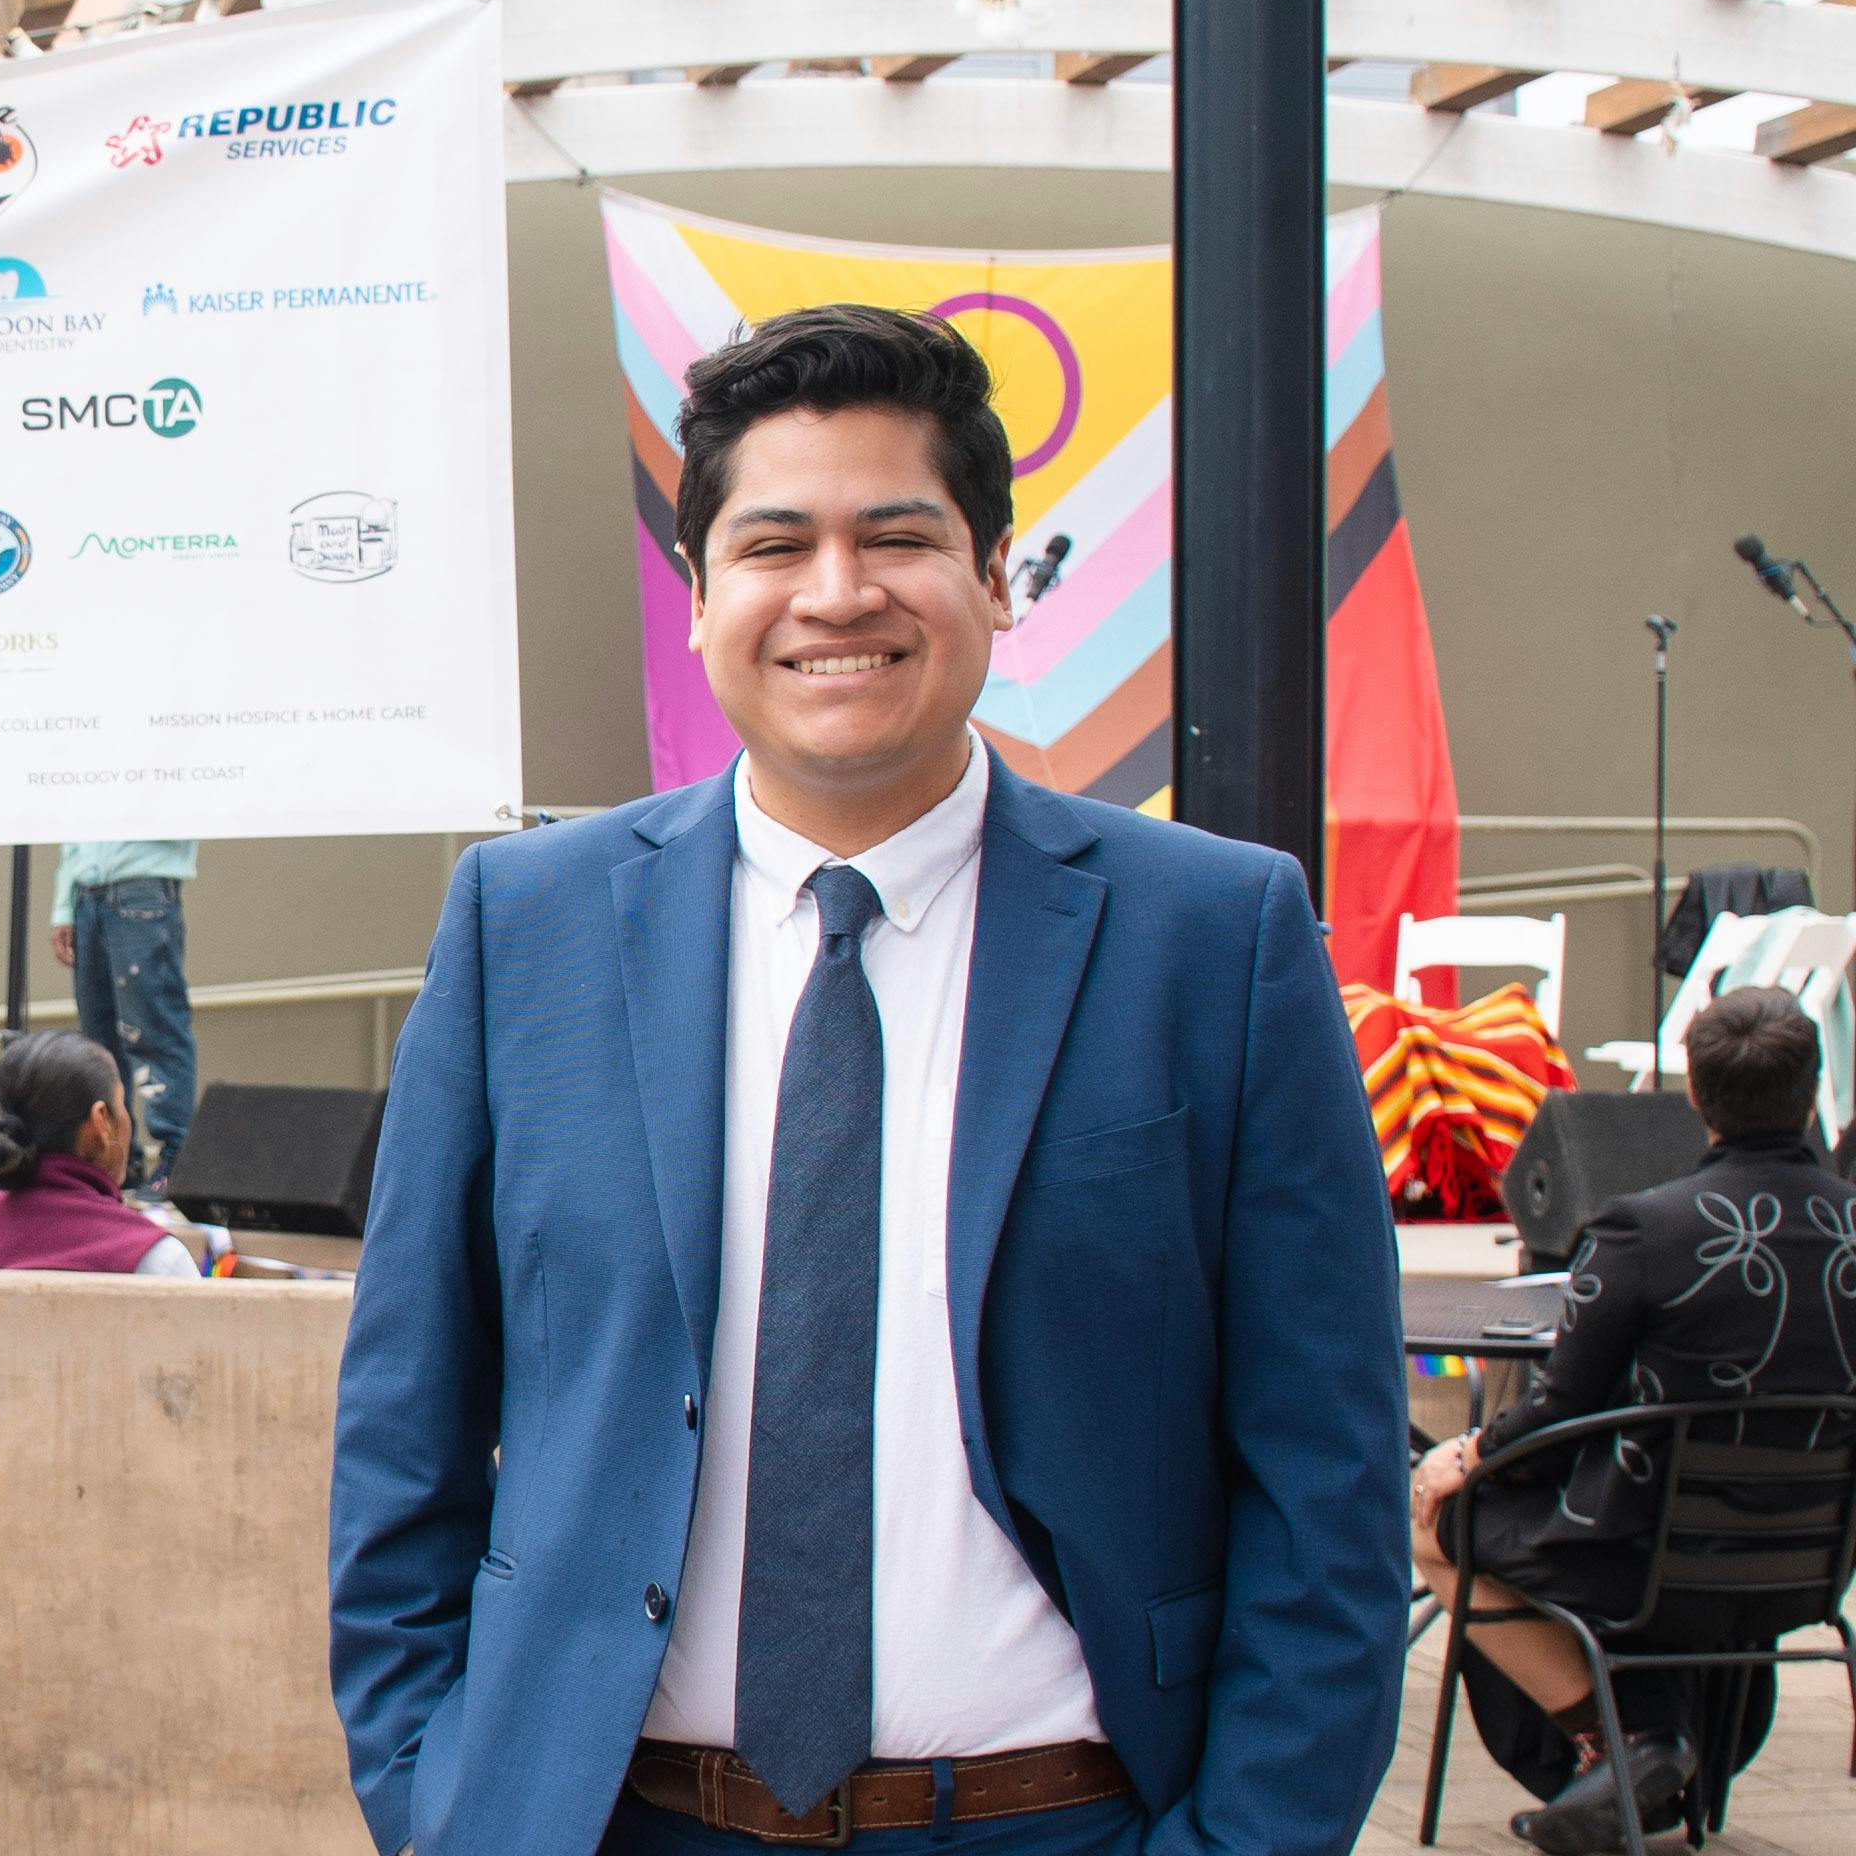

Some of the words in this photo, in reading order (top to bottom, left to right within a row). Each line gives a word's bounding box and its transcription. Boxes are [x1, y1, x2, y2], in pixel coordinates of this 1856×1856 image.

[177, 96, 398, 138] REPUBLIC
[226, 135, 349, 160] SERVICES
[189, 290, 264, 314] KAISER
[273, 281, 429, 310] PERMANENTE
[64, 312, 108, 333] BAY
[67, 532, 240, 560] MONTERRA
[0, 714, 103, 733] COLLECTIVE
[148, 711, 222, 729] MISSION
[226, 708, 301, 726] HOSPICE
[306, 708, 319, 723] &
[322, 705, 376, 723] HOME
[380, 704, 427, 721] CARE
[26, 768, 121, 787] RECOLOGY
[124, 768, 149, 784] OF
[152, 766, 186, 783] THE
[191, 764, 248, 782] COAST
